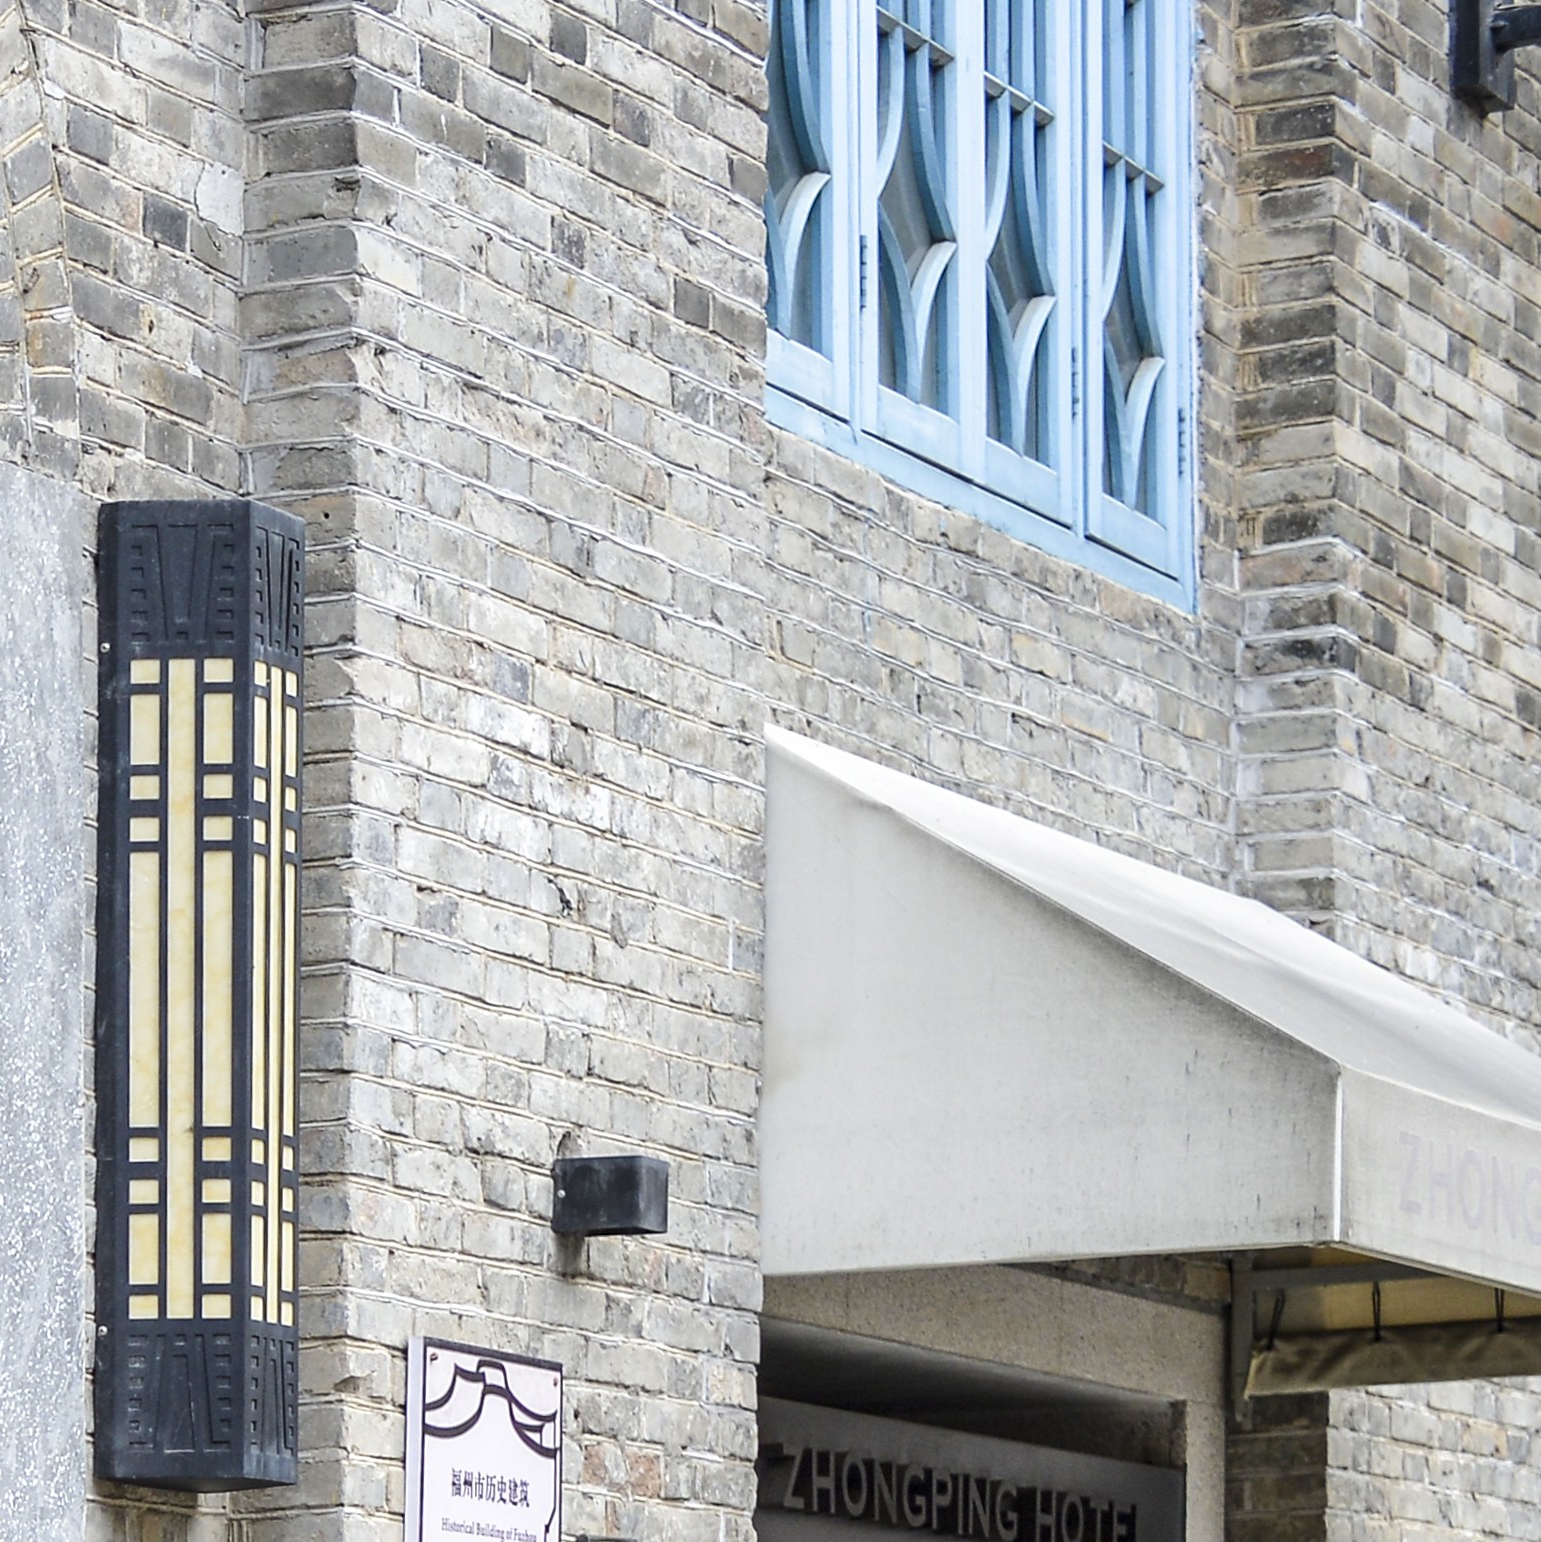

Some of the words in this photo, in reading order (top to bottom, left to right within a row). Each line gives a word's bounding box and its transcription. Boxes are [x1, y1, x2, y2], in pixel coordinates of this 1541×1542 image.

[451, 1467, 530, 1508] 福州市历史建筑
[782, 1443, 1019, 1542] ZHONGPING
[441, 1517, 474, 1535] Historical
[476, 1522, 505, 1542] Building
